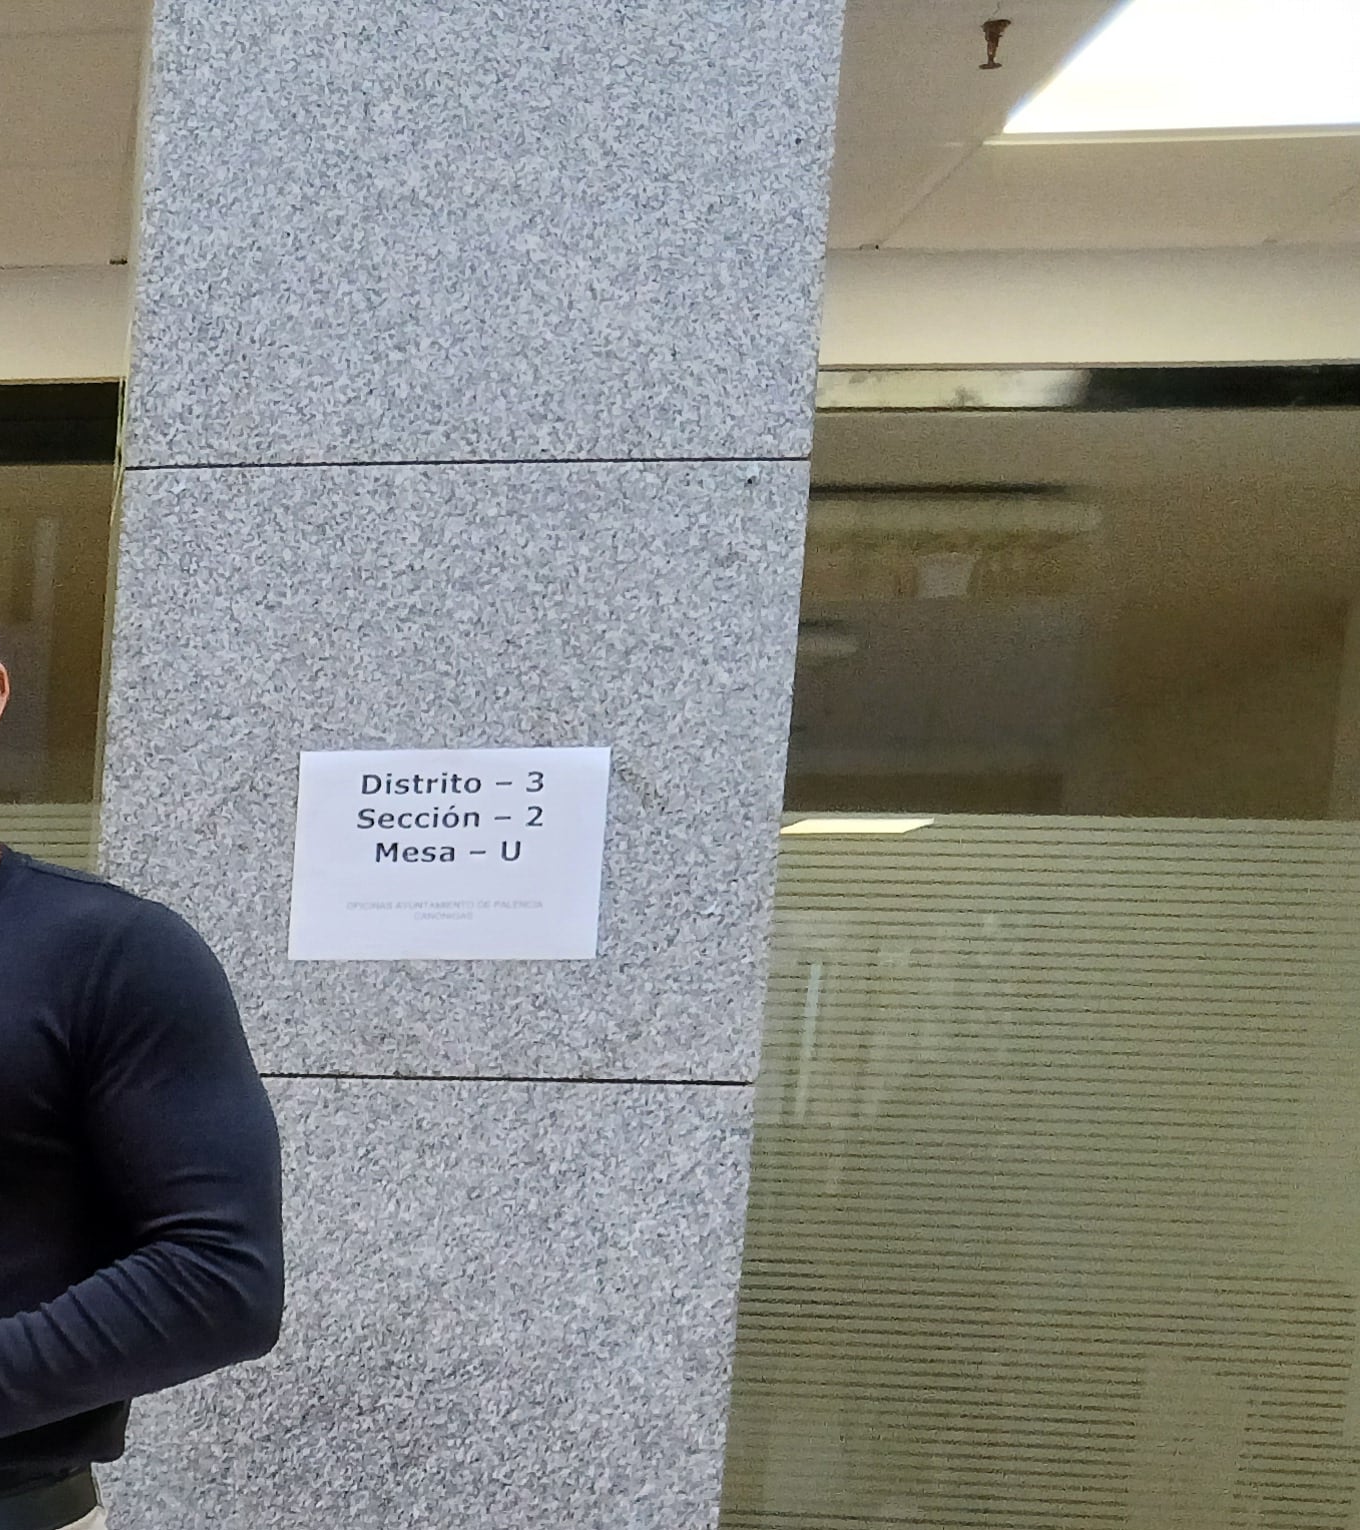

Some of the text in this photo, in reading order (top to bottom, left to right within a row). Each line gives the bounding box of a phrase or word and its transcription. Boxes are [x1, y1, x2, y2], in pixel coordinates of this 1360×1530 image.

[361, 772, 482, 795] Distrito
[526, 771, 544, 793] 3
[356, 805, 480, 829] Sección
[525, 806, 544, 827] 2
[375, 842, 455, 863] Mesa
[501, 840, 521, 861] U
